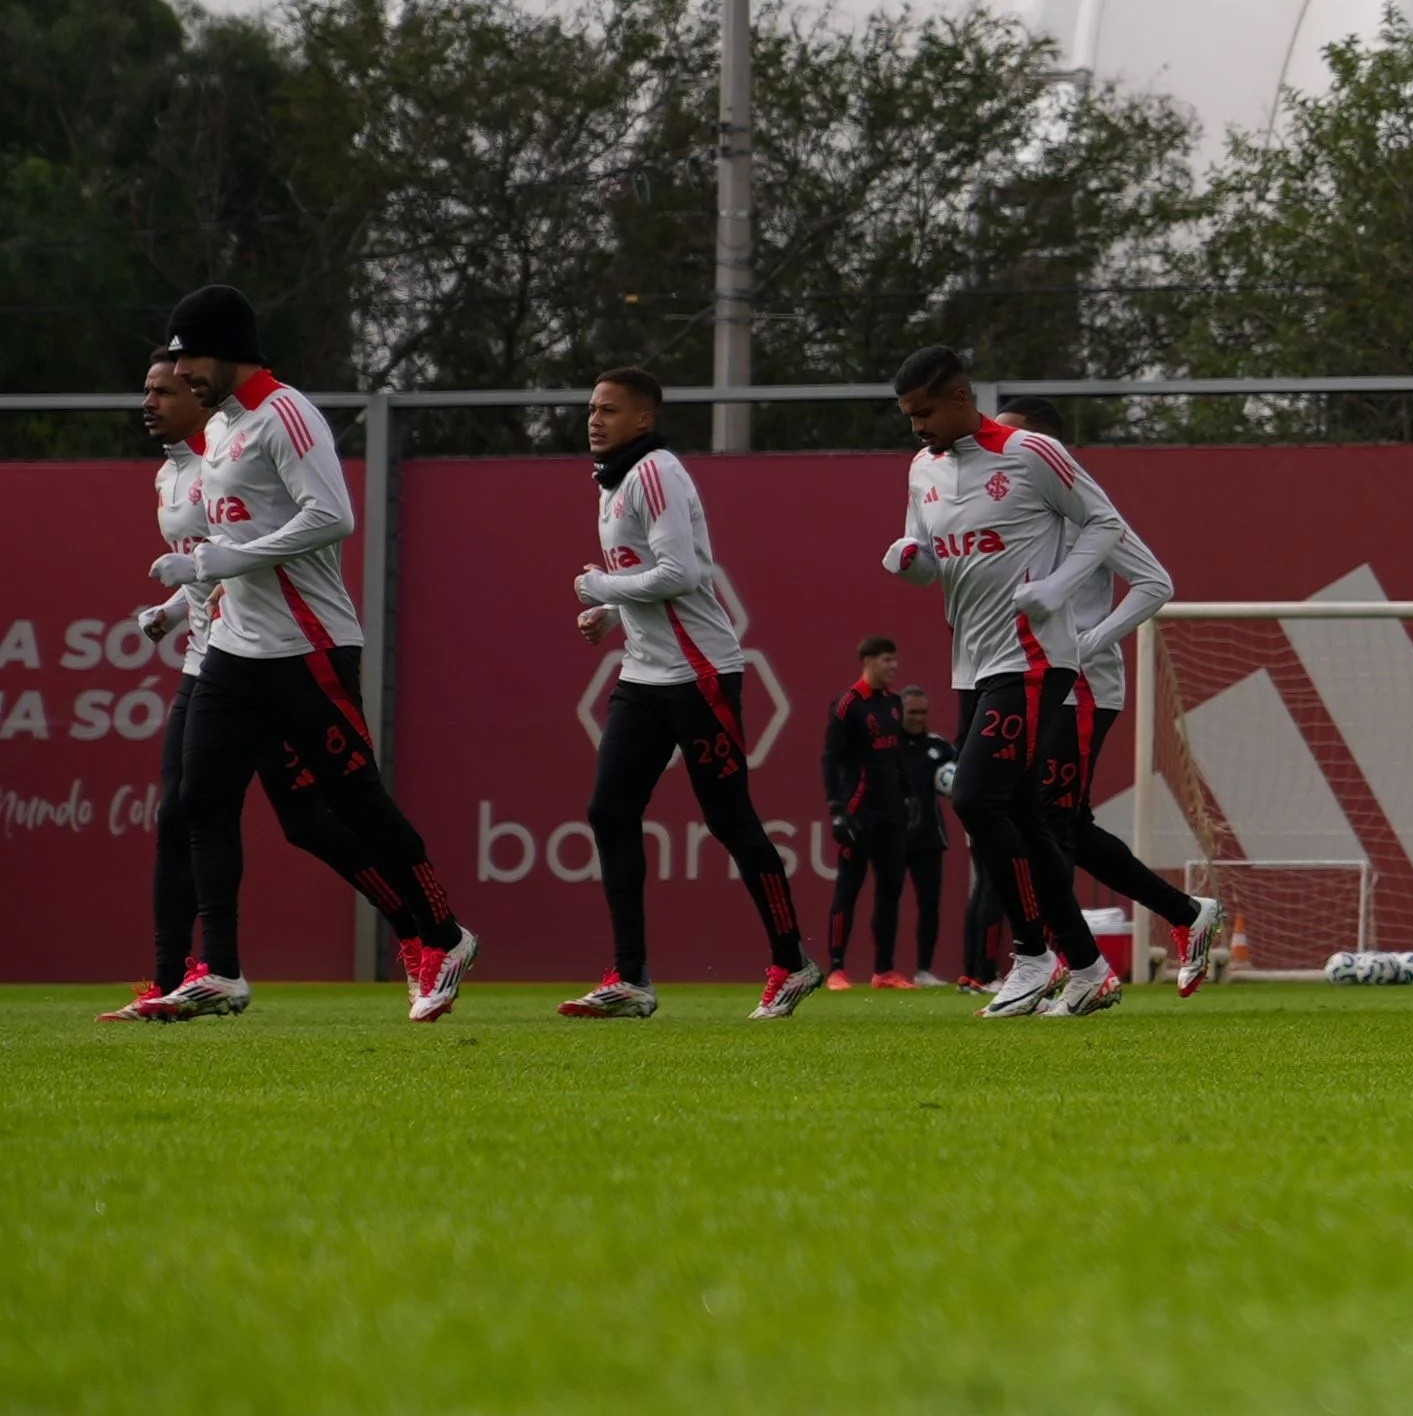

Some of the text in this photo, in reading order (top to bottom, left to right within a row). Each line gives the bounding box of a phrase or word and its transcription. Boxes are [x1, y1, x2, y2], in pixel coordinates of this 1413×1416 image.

[206, 496, 252, 524] lfa
[933, 528, 1005, 558] alfa
[603, 546, 642, 571] lfa
[979, 710, 1022, 741] 20
[691, 731, 731, 765] 28
[1041, 757, 1076, 788] 39
